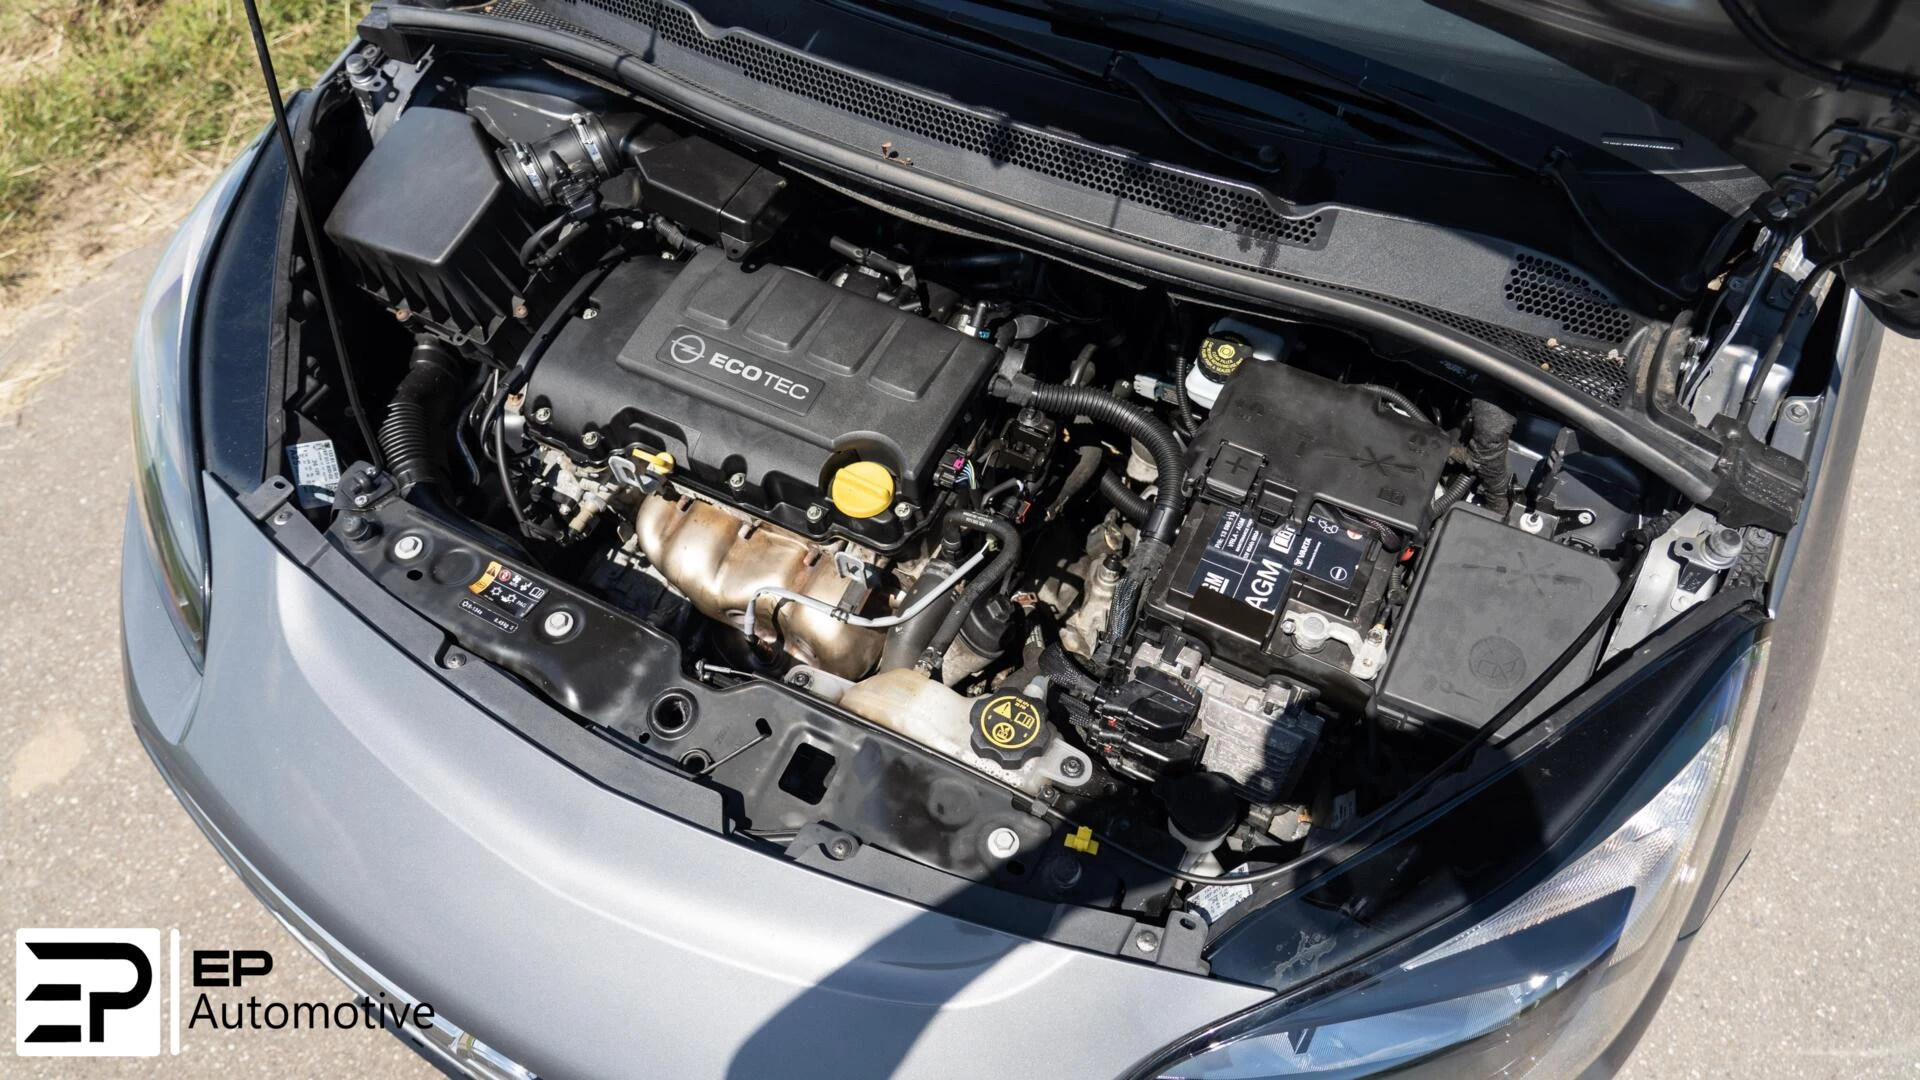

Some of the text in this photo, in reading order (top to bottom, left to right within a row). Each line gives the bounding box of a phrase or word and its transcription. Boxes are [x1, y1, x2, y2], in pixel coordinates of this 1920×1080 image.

[709, 352, 809, 400] ECOTEC
[1226, 532, 1238, 547] VRLA
[1234, 517, 1246, 530] AGM
[1297, 537, 1312, 559] VARTA
[1245, 558, 1283, 610] AGM
